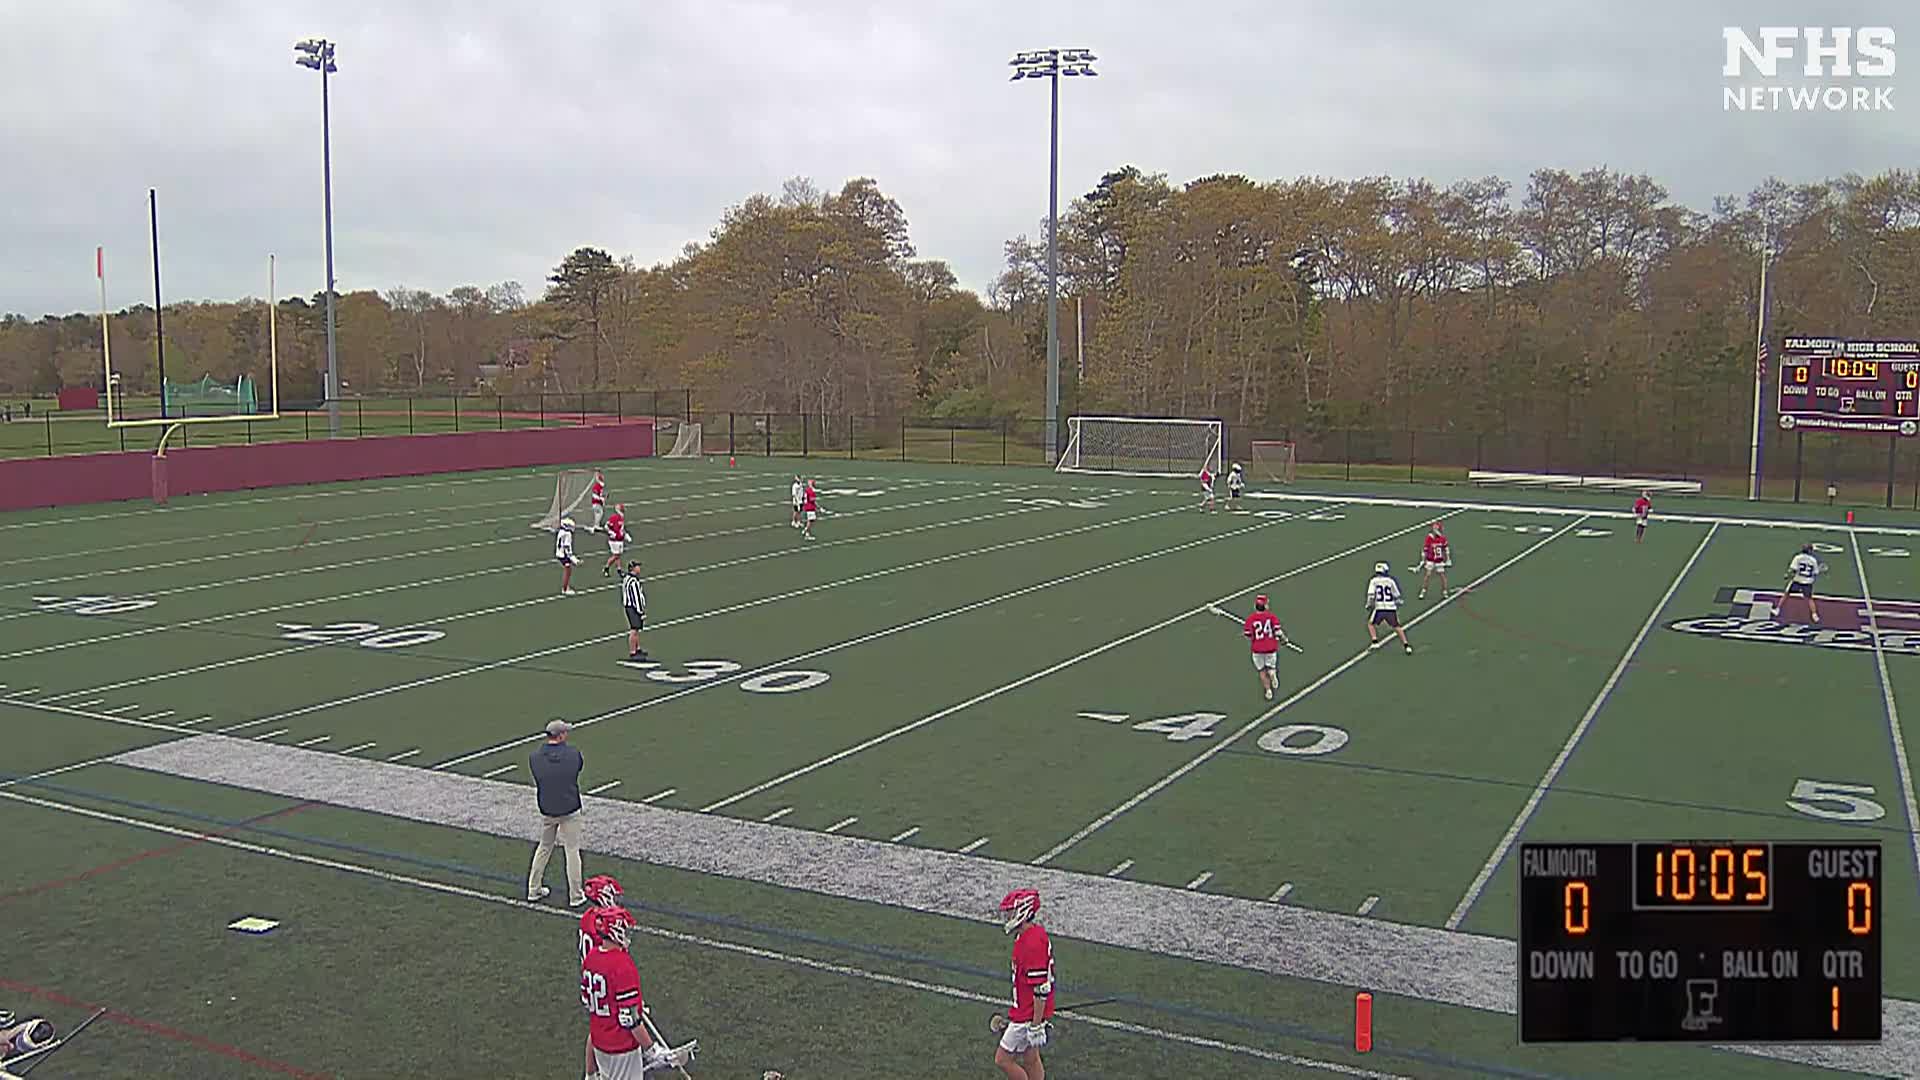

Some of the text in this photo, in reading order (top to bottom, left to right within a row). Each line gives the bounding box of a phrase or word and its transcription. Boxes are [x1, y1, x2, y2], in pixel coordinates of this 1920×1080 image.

[1847, 343, 1874, 352] HIGH
[1876, 343, 1920, 353] SCHOOL
[1796, 367, 1807, 382] 0
[1831, 359, 1876, 376] 10:04
[1906, 371, 1917, 388] 0
[1816, 387, 1827, 396] TO
[1799, 563, 1814, 577] 23
[1252, 619, 1273, 640] 24
[646, 659, 831, 693] 30
[1132, 712, 1349, 756] 40
[581, 969, 610, 1016] 32
